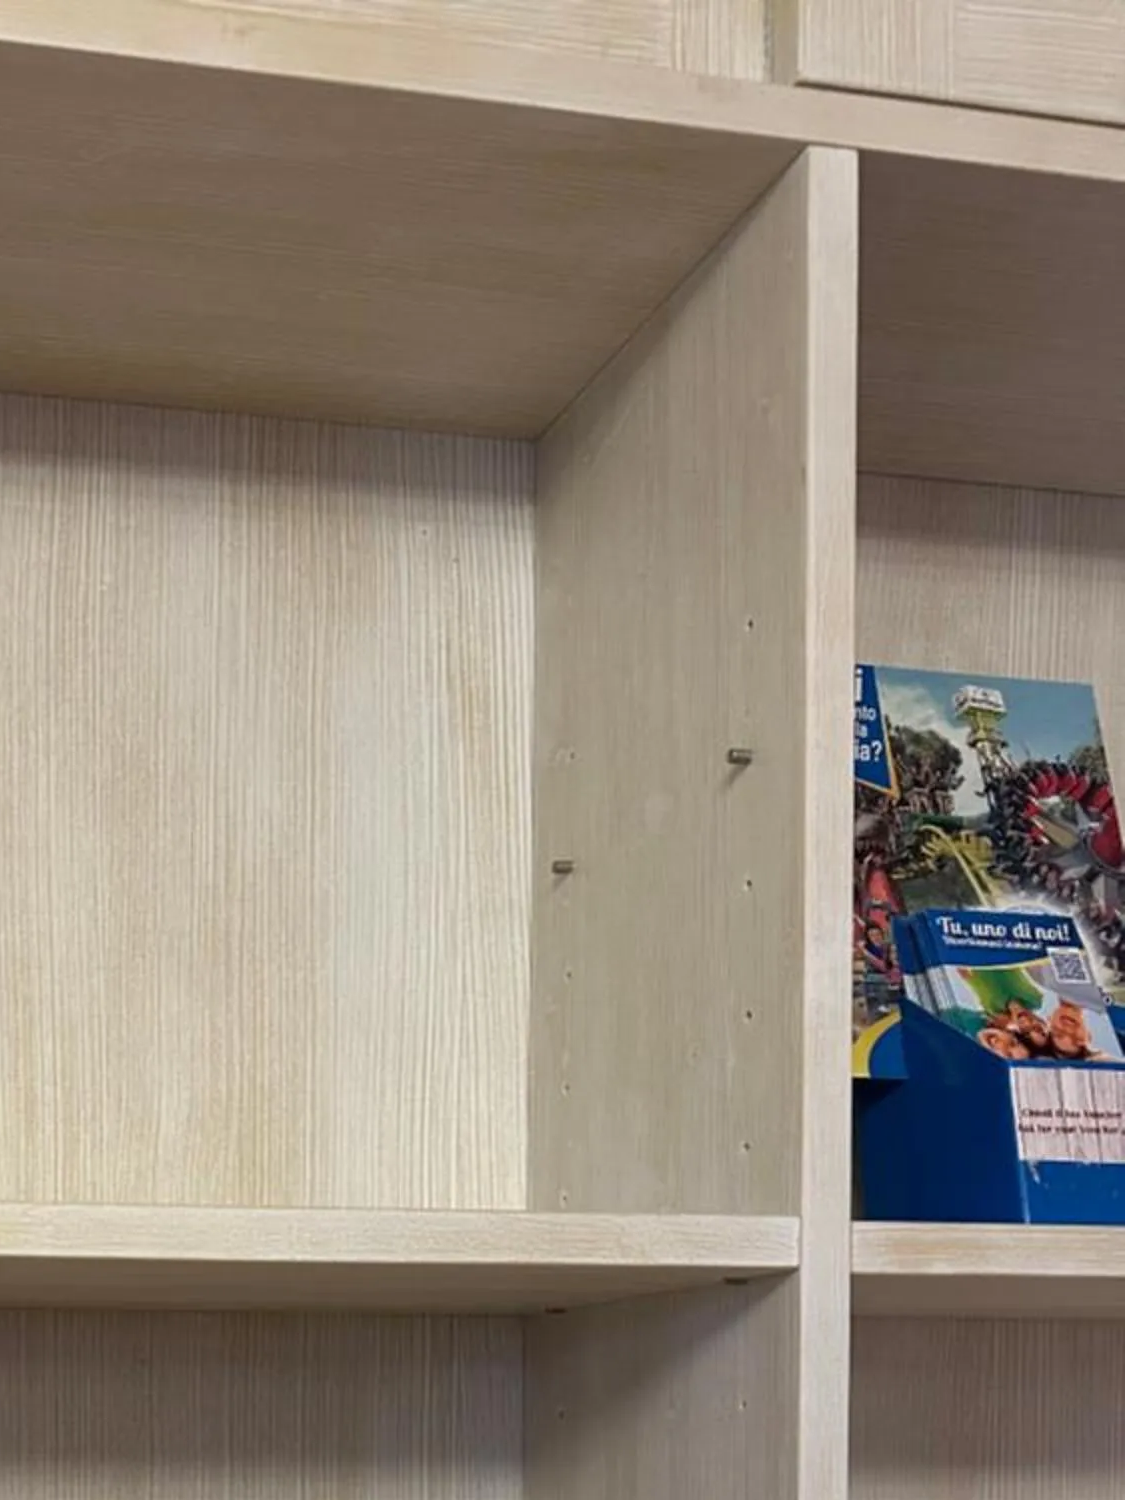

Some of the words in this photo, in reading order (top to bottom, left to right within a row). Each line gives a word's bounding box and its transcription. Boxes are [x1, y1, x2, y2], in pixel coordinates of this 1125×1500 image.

[936, 916, 969, 937] Tu,
[972, 922, 1007, 938] uno
[1012, 921, 1032, 939] di
[1035, 923, 1071, 942] noi!
